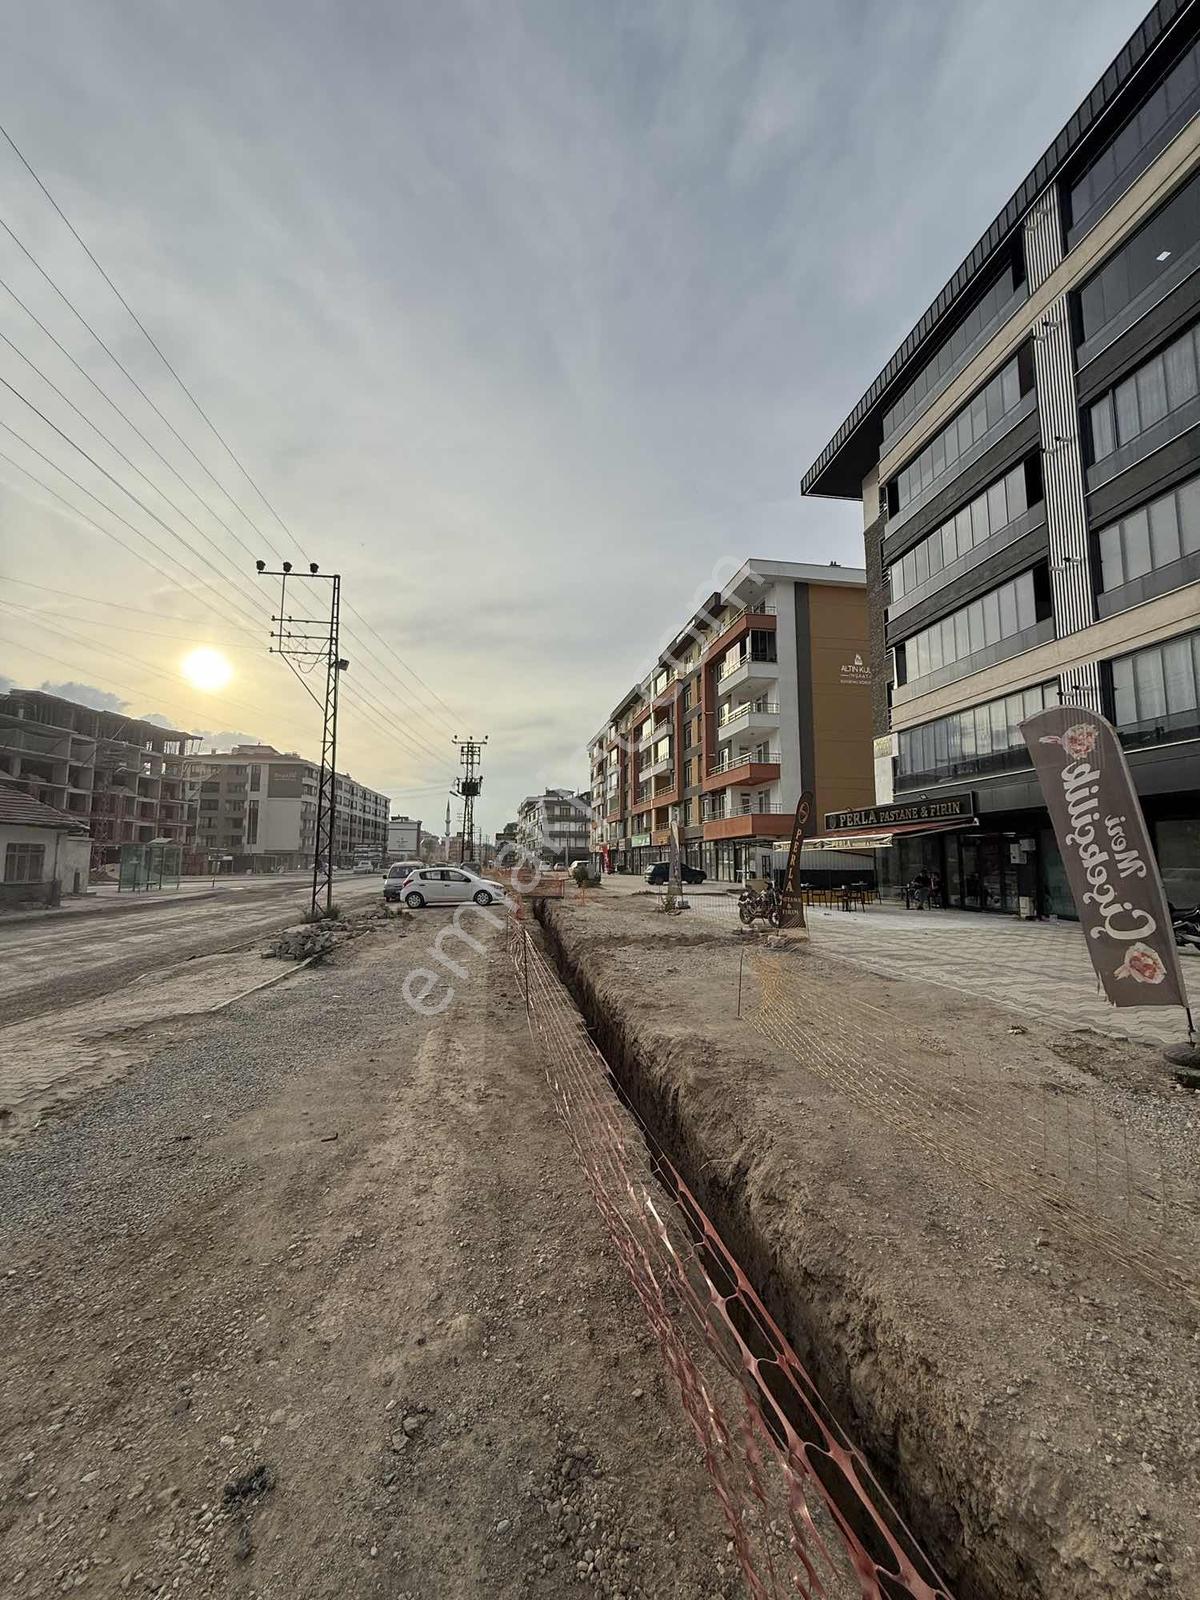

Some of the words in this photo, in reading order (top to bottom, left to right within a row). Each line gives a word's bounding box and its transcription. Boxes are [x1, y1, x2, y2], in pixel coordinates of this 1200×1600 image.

[840, 810, 877, 827] PERLA
[880, 808, 918, 822] PASTANE
[920, 806, 929, 818] &
[930, 801, 960, 817] FIRIN
[785, 828, 802, 893] PERLA
